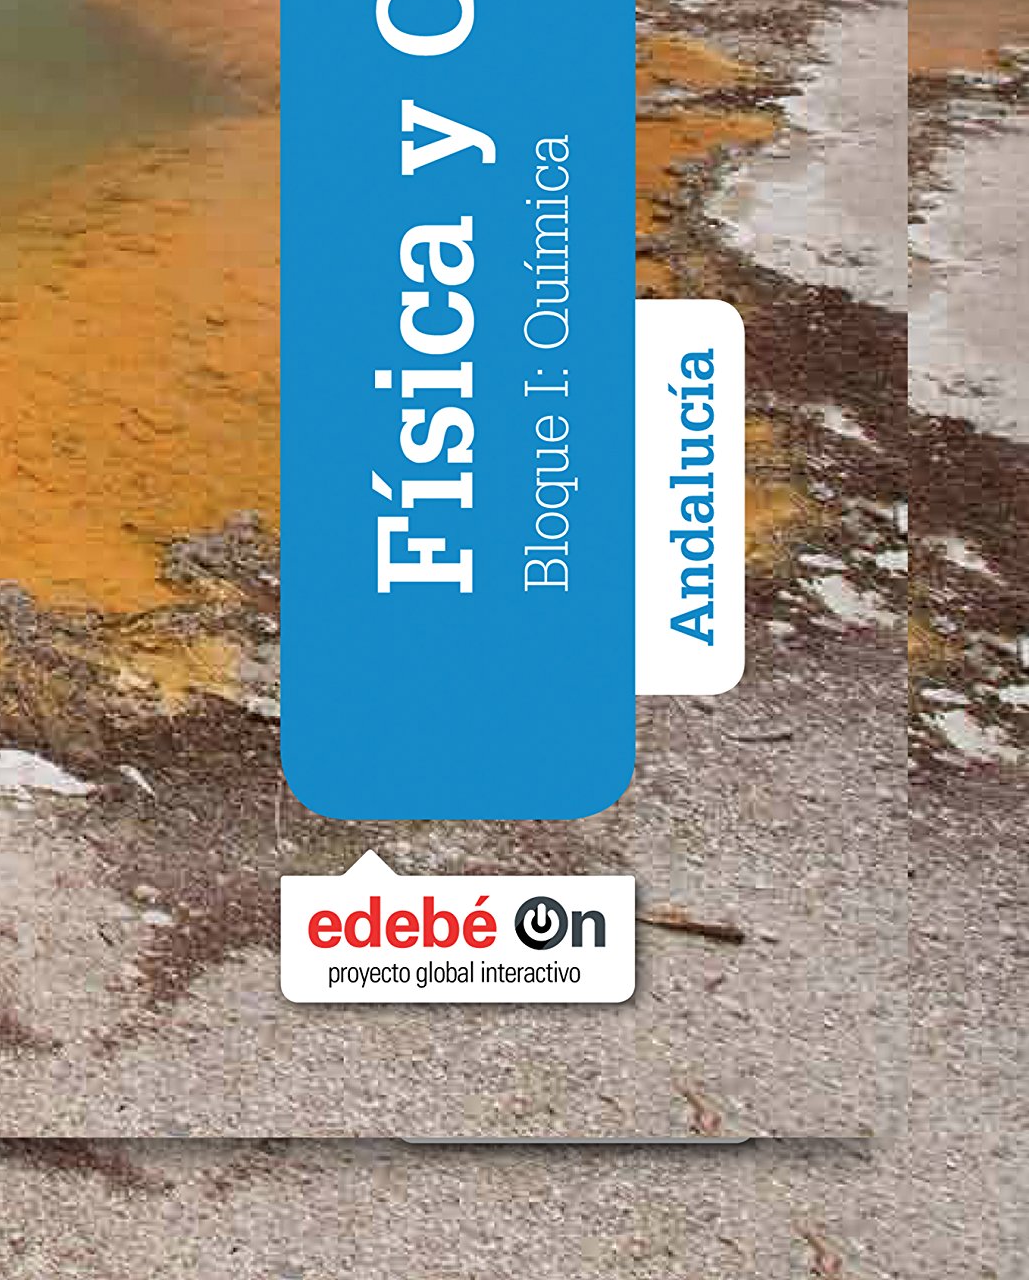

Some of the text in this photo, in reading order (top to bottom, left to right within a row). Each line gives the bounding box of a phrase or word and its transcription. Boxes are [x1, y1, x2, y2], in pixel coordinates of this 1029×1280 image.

[402, 100, 496, 175] y
[372, 216, 474, 593] Física
[524, 135, 578, 591] Bloque I: Química
[668, 348, 714, 646] Andalucía
[308, 896, 605, 950] edebé On
[329, 961, 580, 988] proyecto global interactivo
